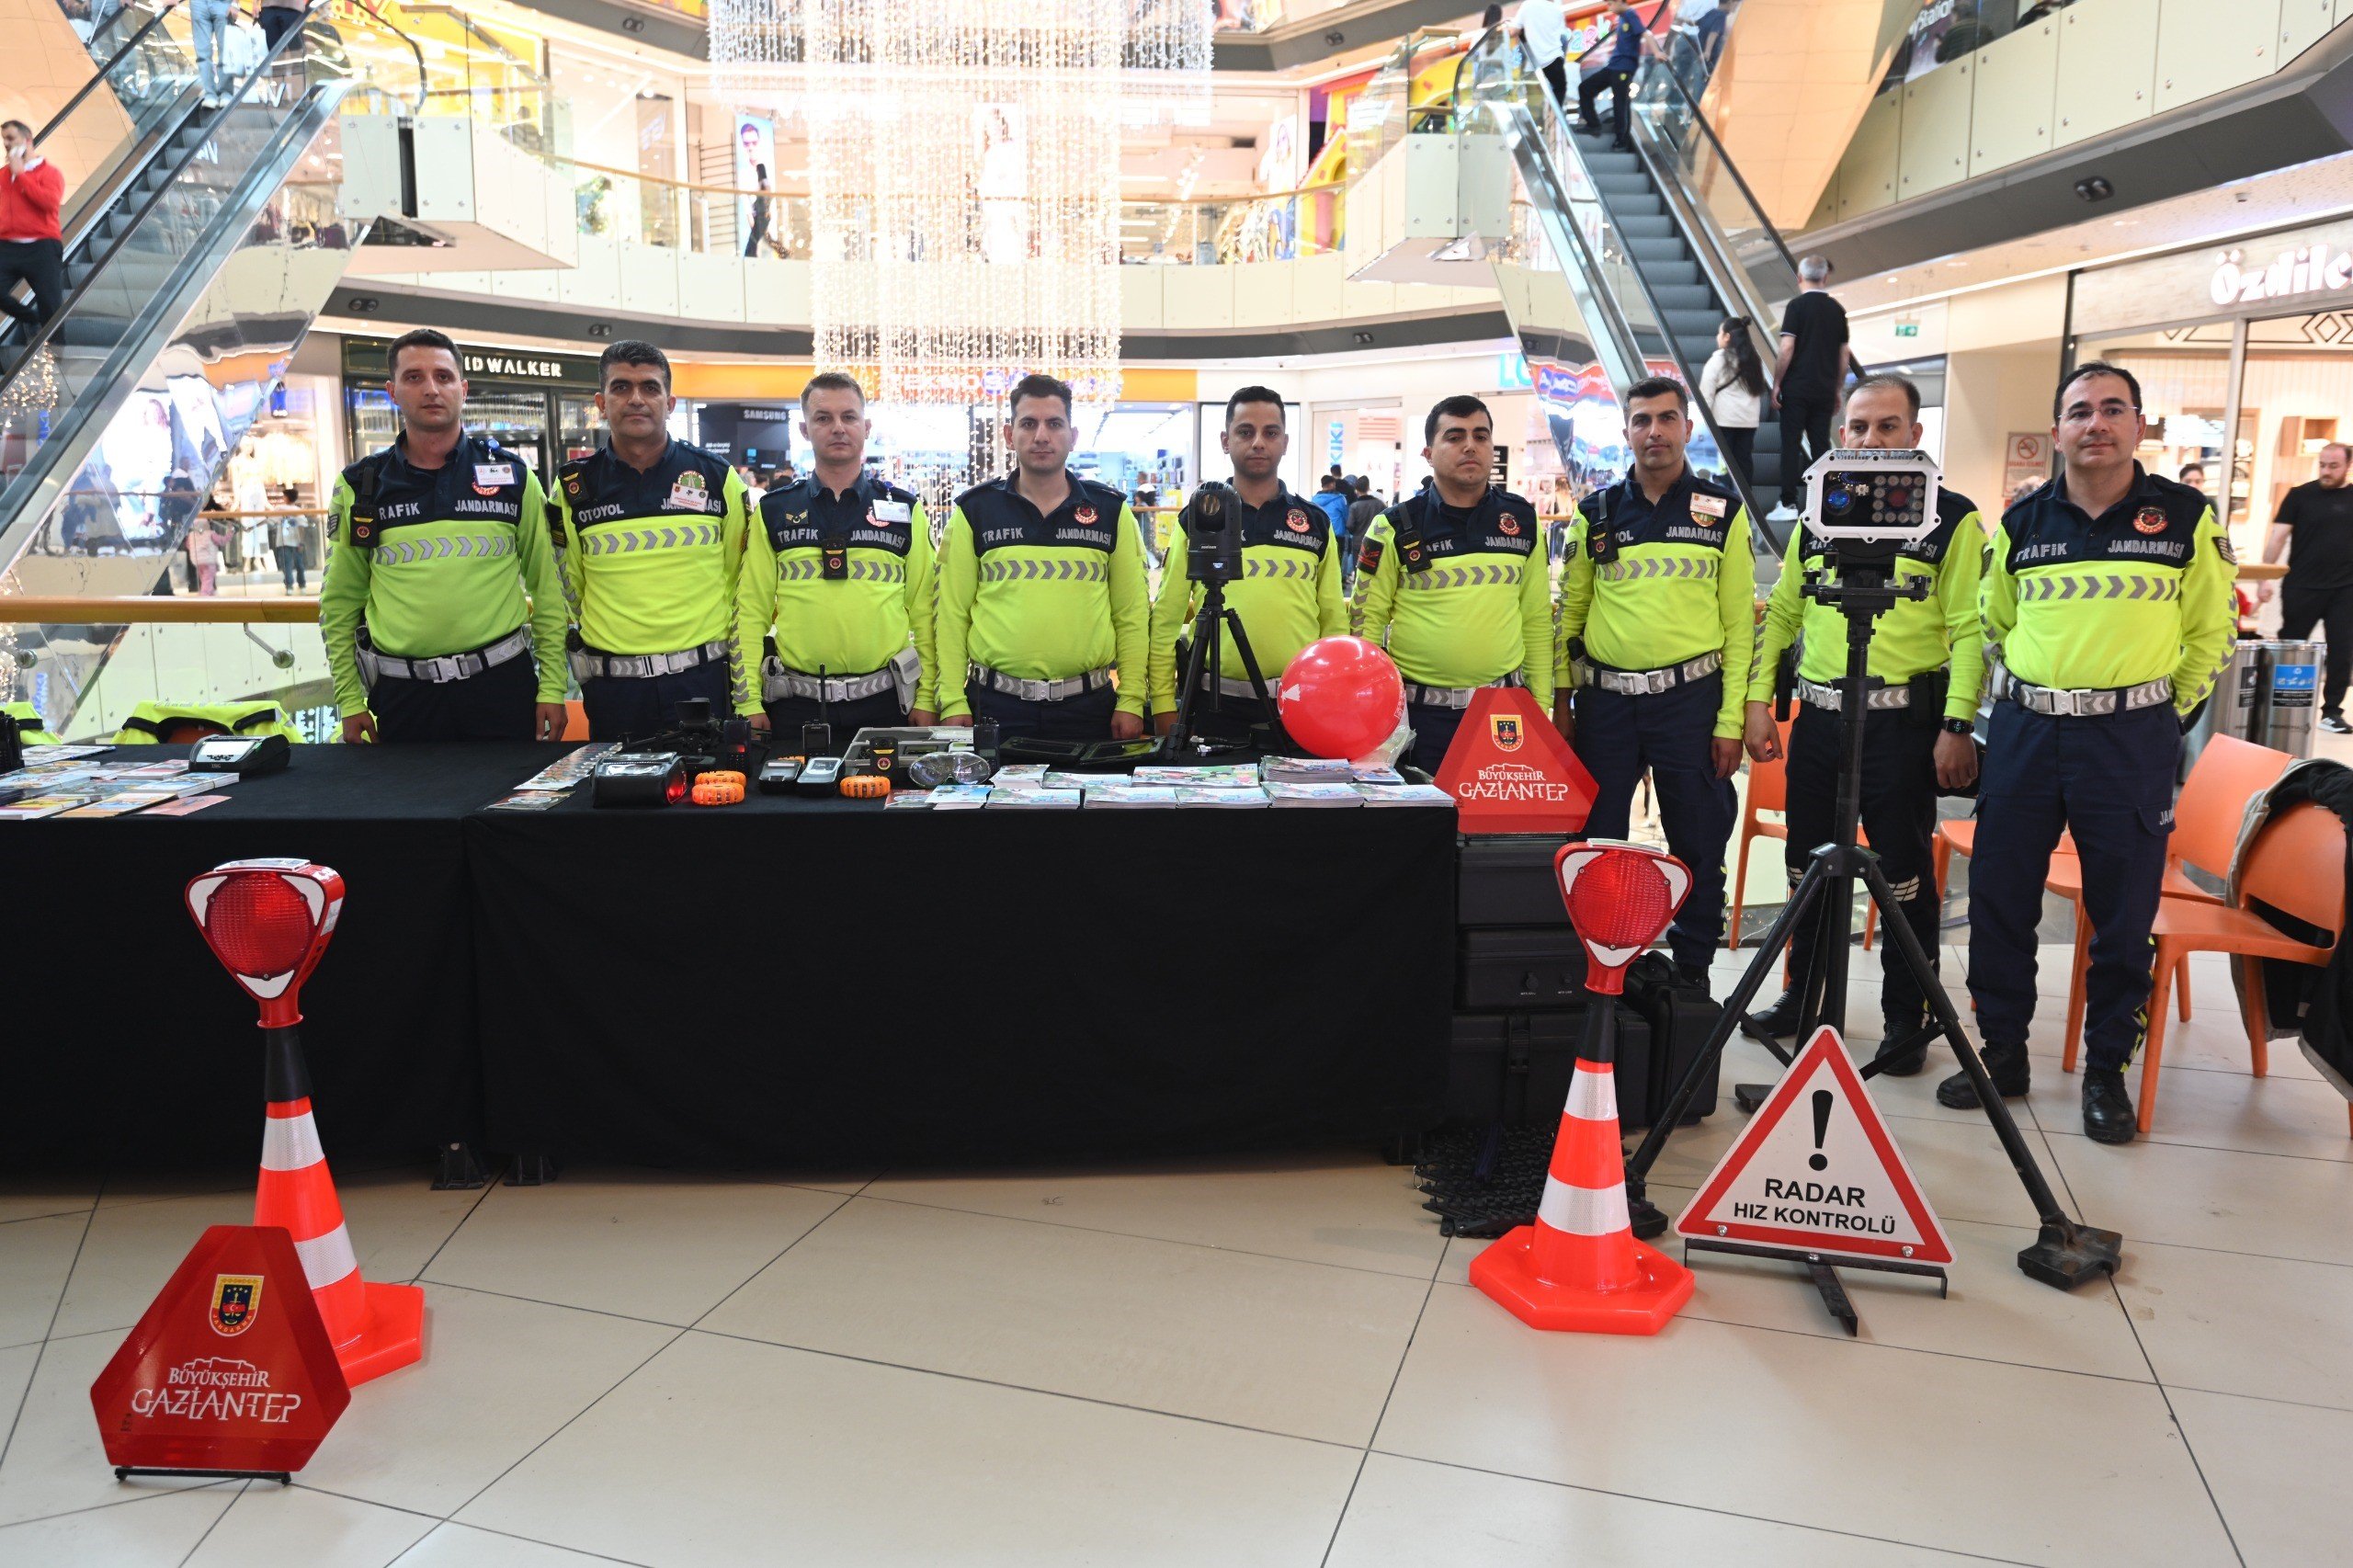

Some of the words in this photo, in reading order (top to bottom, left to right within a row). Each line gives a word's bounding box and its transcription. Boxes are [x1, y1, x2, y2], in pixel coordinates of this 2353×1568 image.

[2211, 243, 2353, 305] Özdile
[486, 358, 563, 378] WALKER
[744, 409, 787, 421] SAMSUNG
[379, 502, 421, 521] RAFİK
[455, 499, 518, 517] JANDARMASI
[578, 504, 625, 523] OTOYOL
[777, 528, 820, 544] TRAFİK
[850, 529, 905, 550] JANDARMASI
[983, 527, 1024, 544] TRAFİK
[1056, 528, 1112, 546] JANDARMASI
[1484, 536, 1532, 552] JANDARMAS
[1665, 526, 1724, 543] JANDARMAS
[2016, 542, 2067, 562] TRAFİK
[2108, 540, 2185, 559] JANDARMASI
[1477, 769, 1546, 782] BÜYÜKŞEHİR
[1459, 780, 1569, 801] GAZİANTEP
[1765, 1177, 1866, 1209] RADAR
[1733, 1202, 1768, 1220] HIZ
[1774, 1206, 1895, 1234] KONTROLÜ
[212, 1313, 253, 1334] JANDARMA
[167, 1367, 271, 1389] BÜYÜKŞEHİR
[131, 1386, 301, 1424] GAZİANTEP
